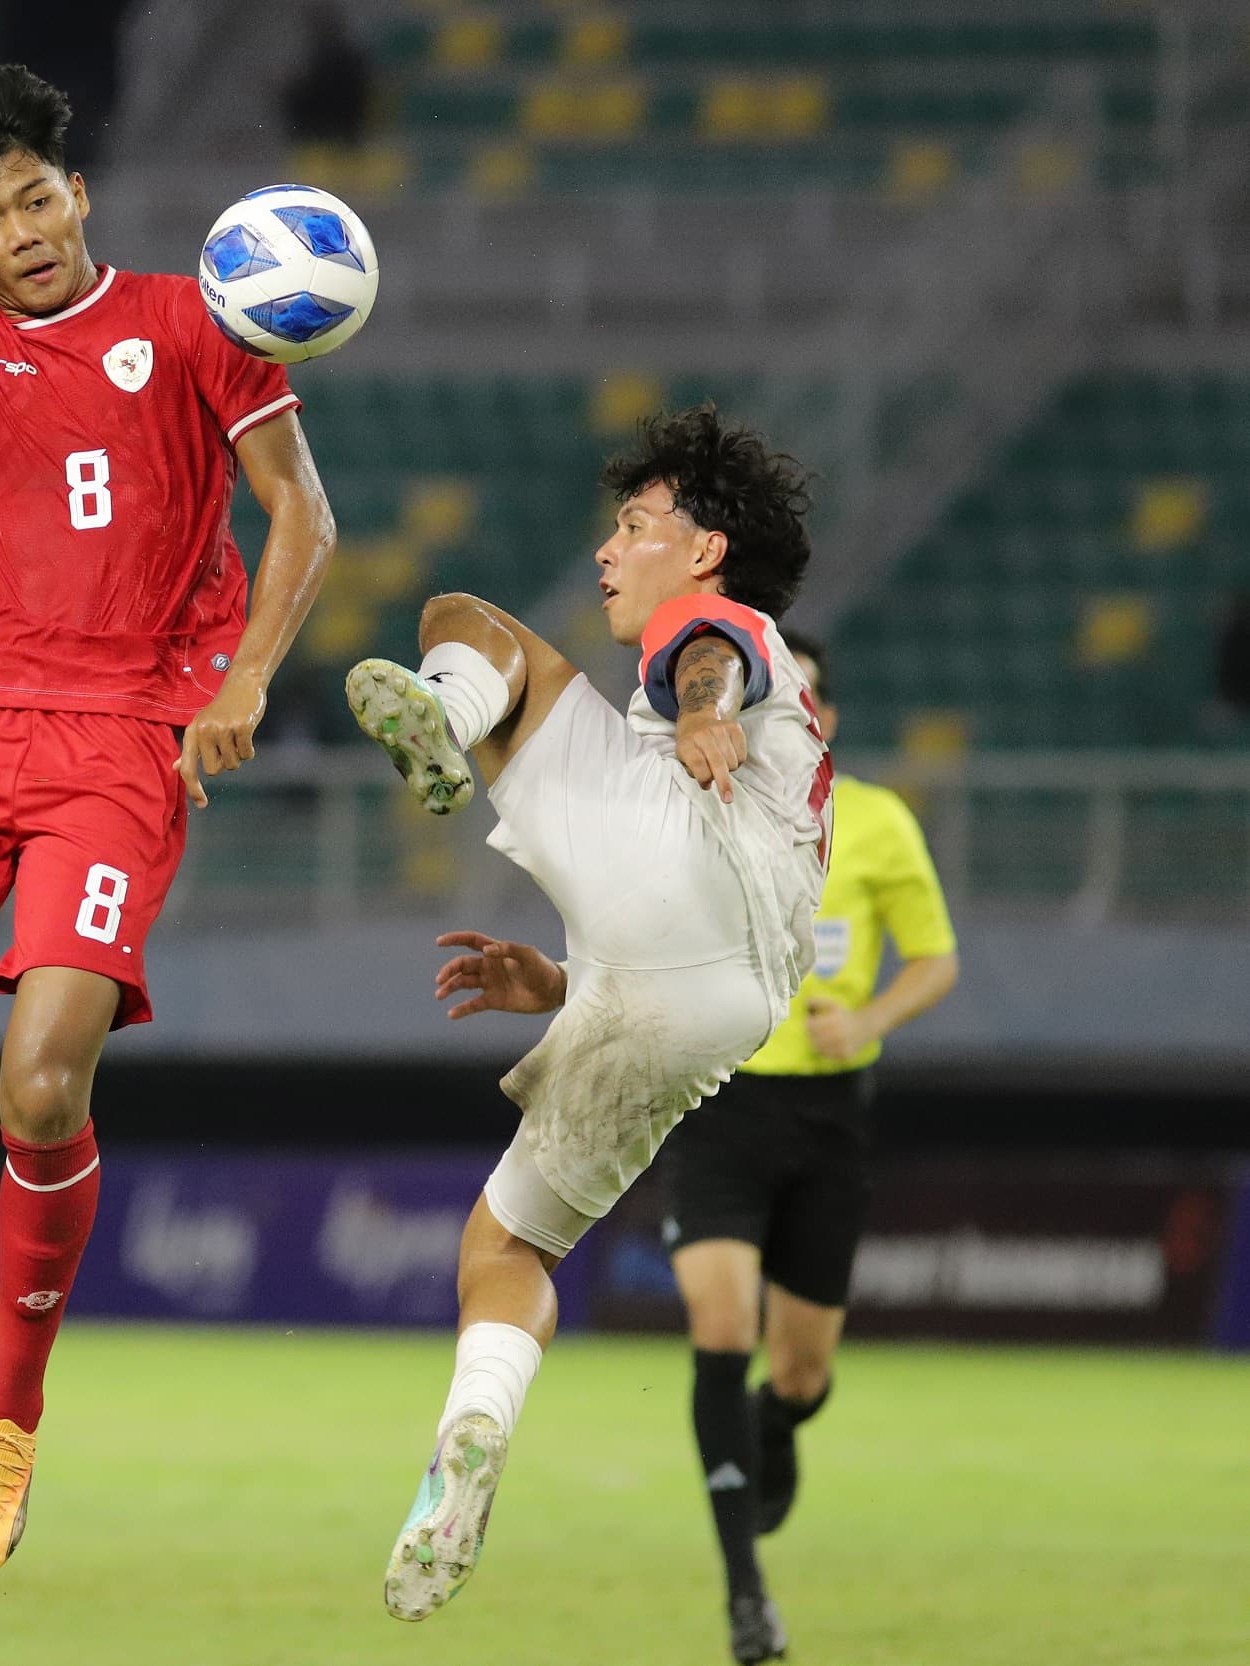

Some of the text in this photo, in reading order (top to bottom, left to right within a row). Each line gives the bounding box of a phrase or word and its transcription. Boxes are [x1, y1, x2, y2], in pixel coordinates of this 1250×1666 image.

[200, 275, 226, 308] olten
[65, 448, 113, 531] 8
[74, 862, 130, 945] 8
